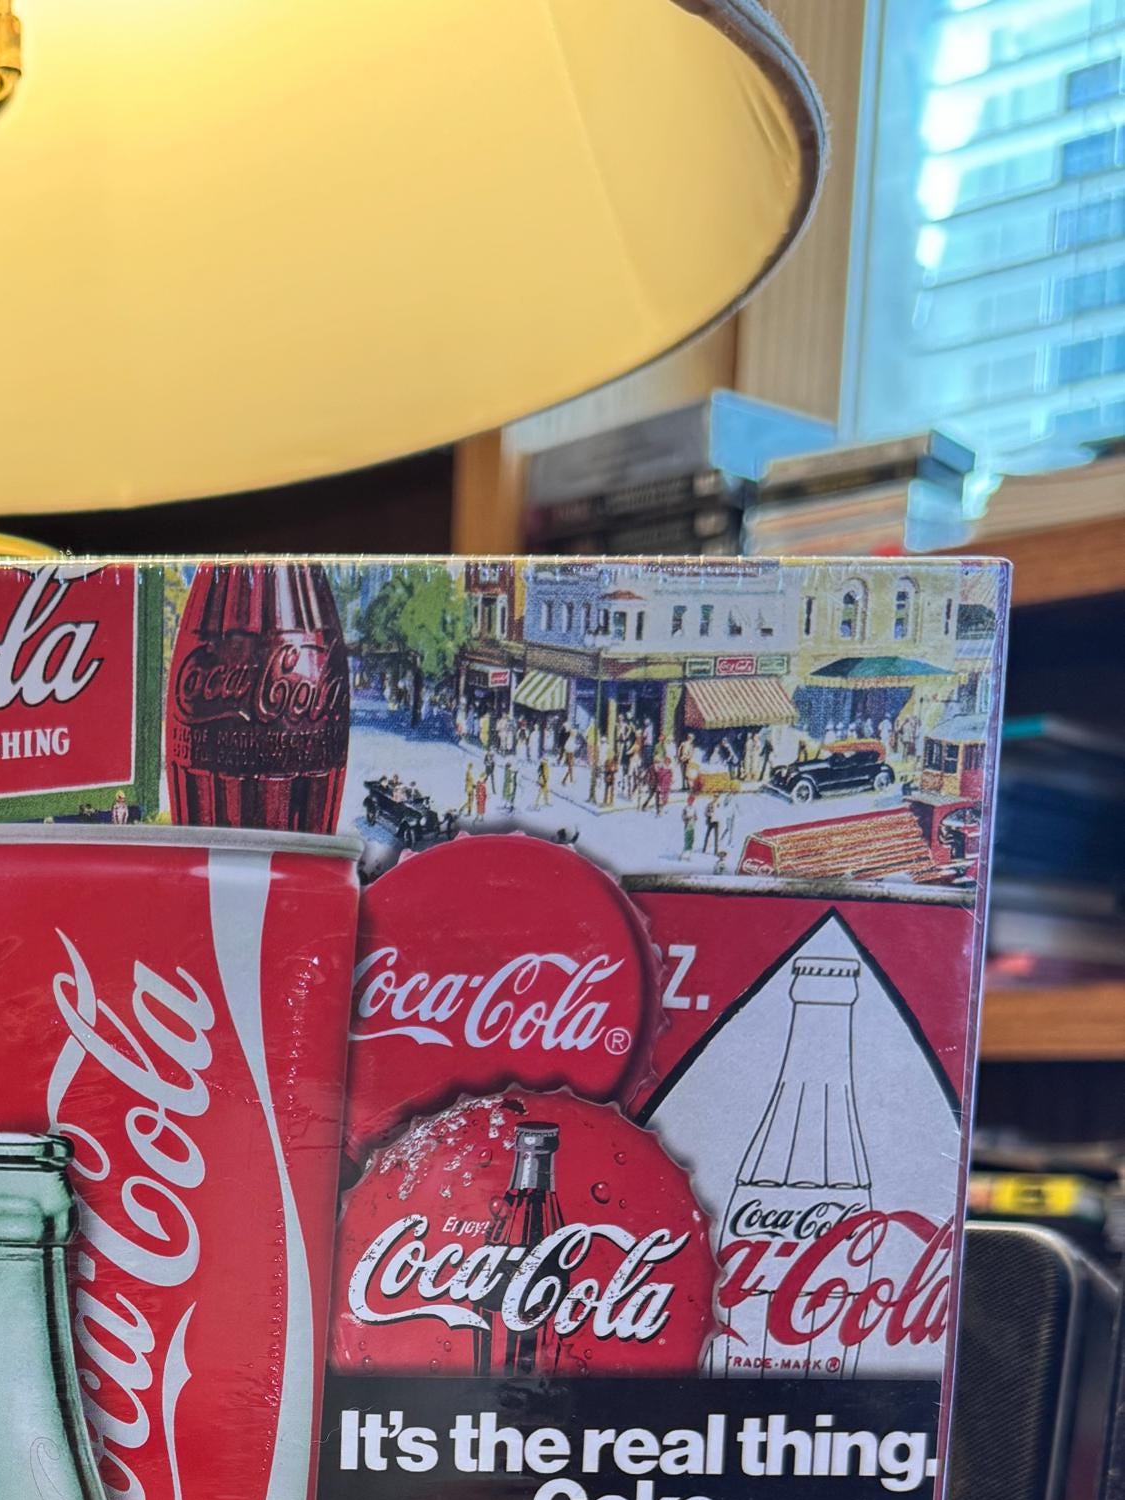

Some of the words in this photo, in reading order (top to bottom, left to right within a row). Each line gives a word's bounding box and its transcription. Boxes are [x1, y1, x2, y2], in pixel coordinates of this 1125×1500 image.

[352, 945, 626, 1052] Coca-Cola
[661, 944, 711, 1011] Z.
[347, 1213, 692, 1342] Coca-Cola
[449, 1411, 571, 1474] the
[582, 1413, 724, 1476] real
[734, 1414, 939, 1493] thing.
